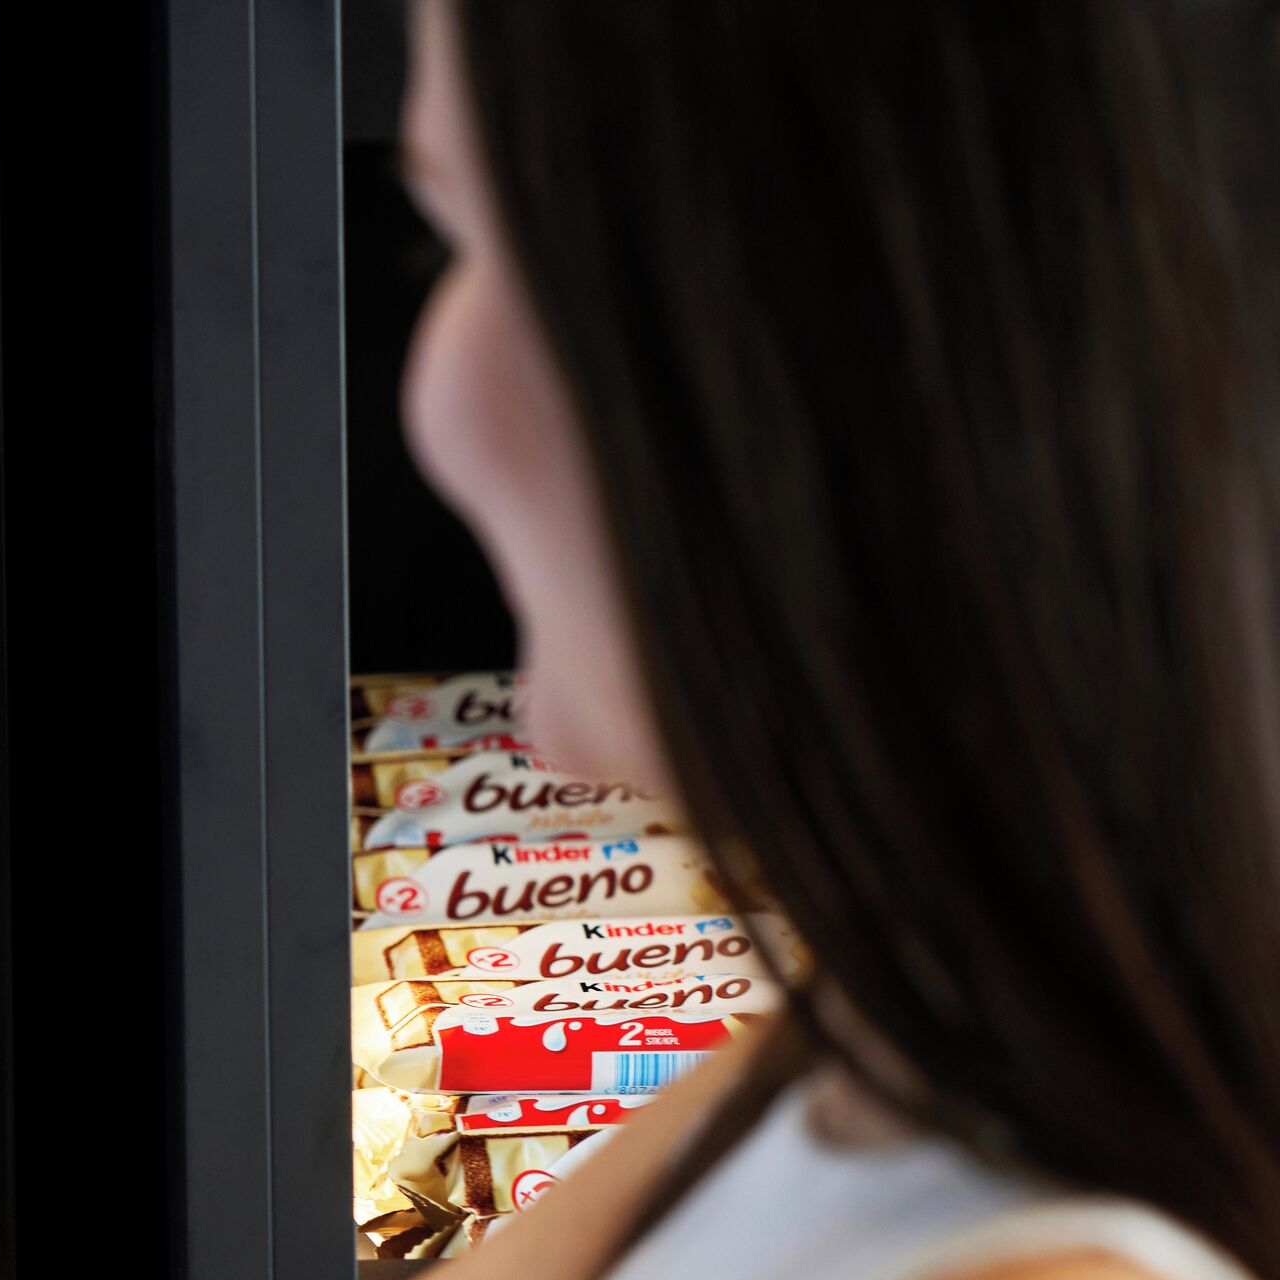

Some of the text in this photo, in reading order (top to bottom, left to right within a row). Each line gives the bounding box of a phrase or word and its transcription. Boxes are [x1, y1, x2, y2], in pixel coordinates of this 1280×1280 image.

[463, 770, 637, 816] buen
[446, 863, 655, 921] bueno
[539, 934, 753, 979] bueno
[532, 977, 753, 1012] bueno
[618, 1021, 645, 1046] 2
